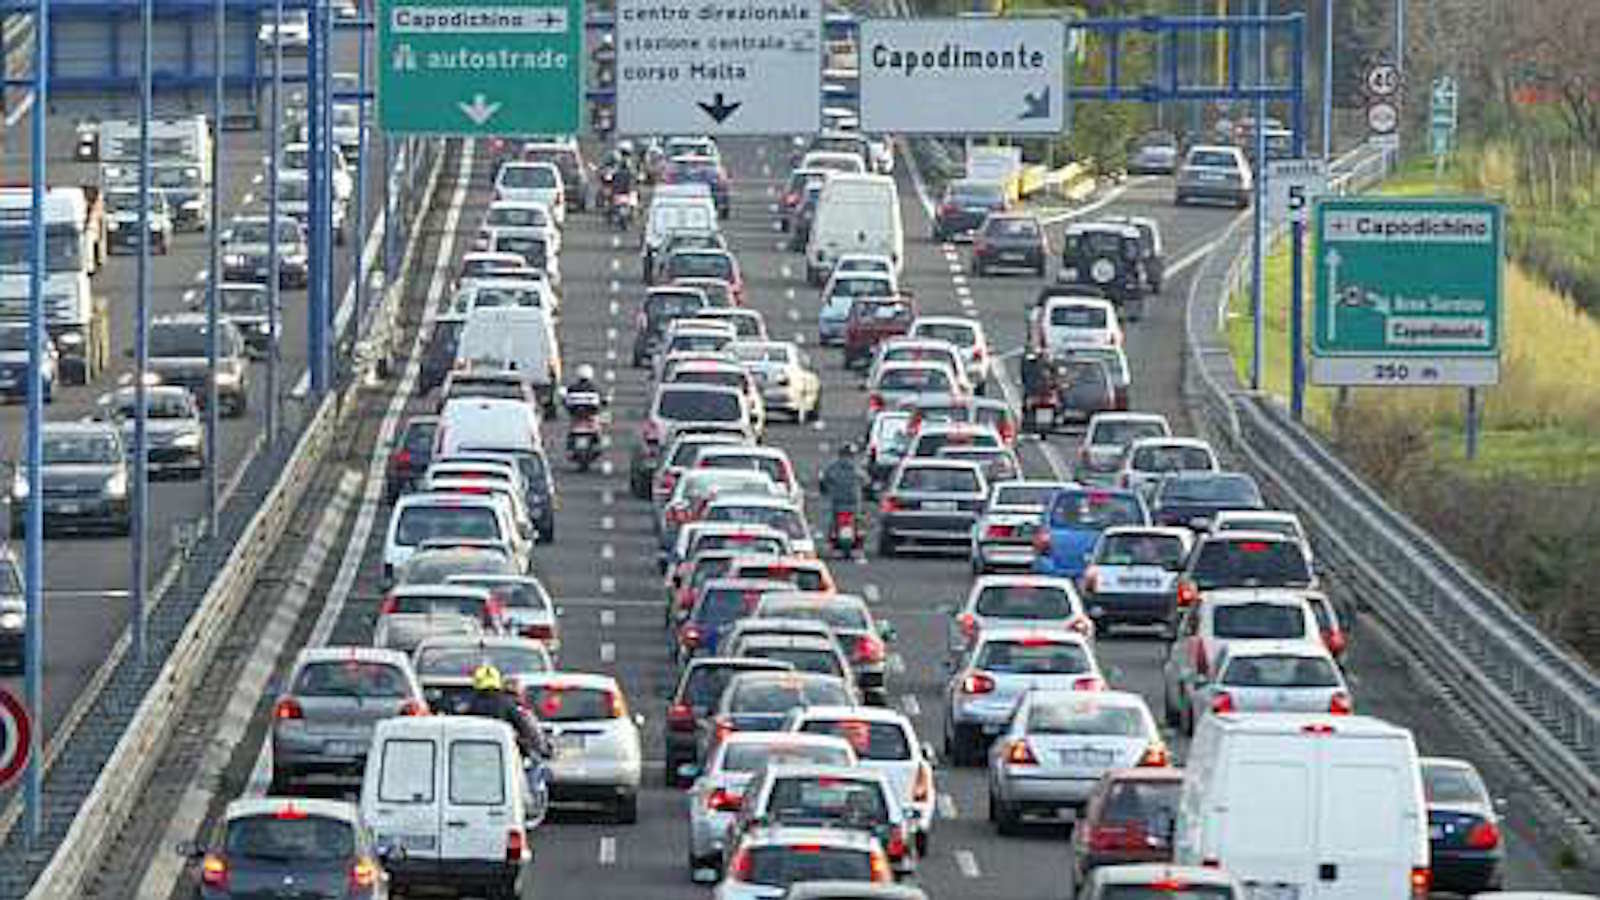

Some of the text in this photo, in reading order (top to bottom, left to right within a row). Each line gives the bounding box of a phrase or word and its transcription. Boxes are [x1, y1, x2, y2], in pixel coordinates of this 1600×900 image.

[396, 11, 523, 28] Capodichino
[623, 4, 810, 20] centro direzionale
[623, 35, 785, 51] stazione centrale
[426, 48, 568, 70] autostrade
[872, 42, 1044, 76] Capodimonte
[623, 61, 747, 81] corso Malta
[1356, 216, 1487, 240] Capodichino
